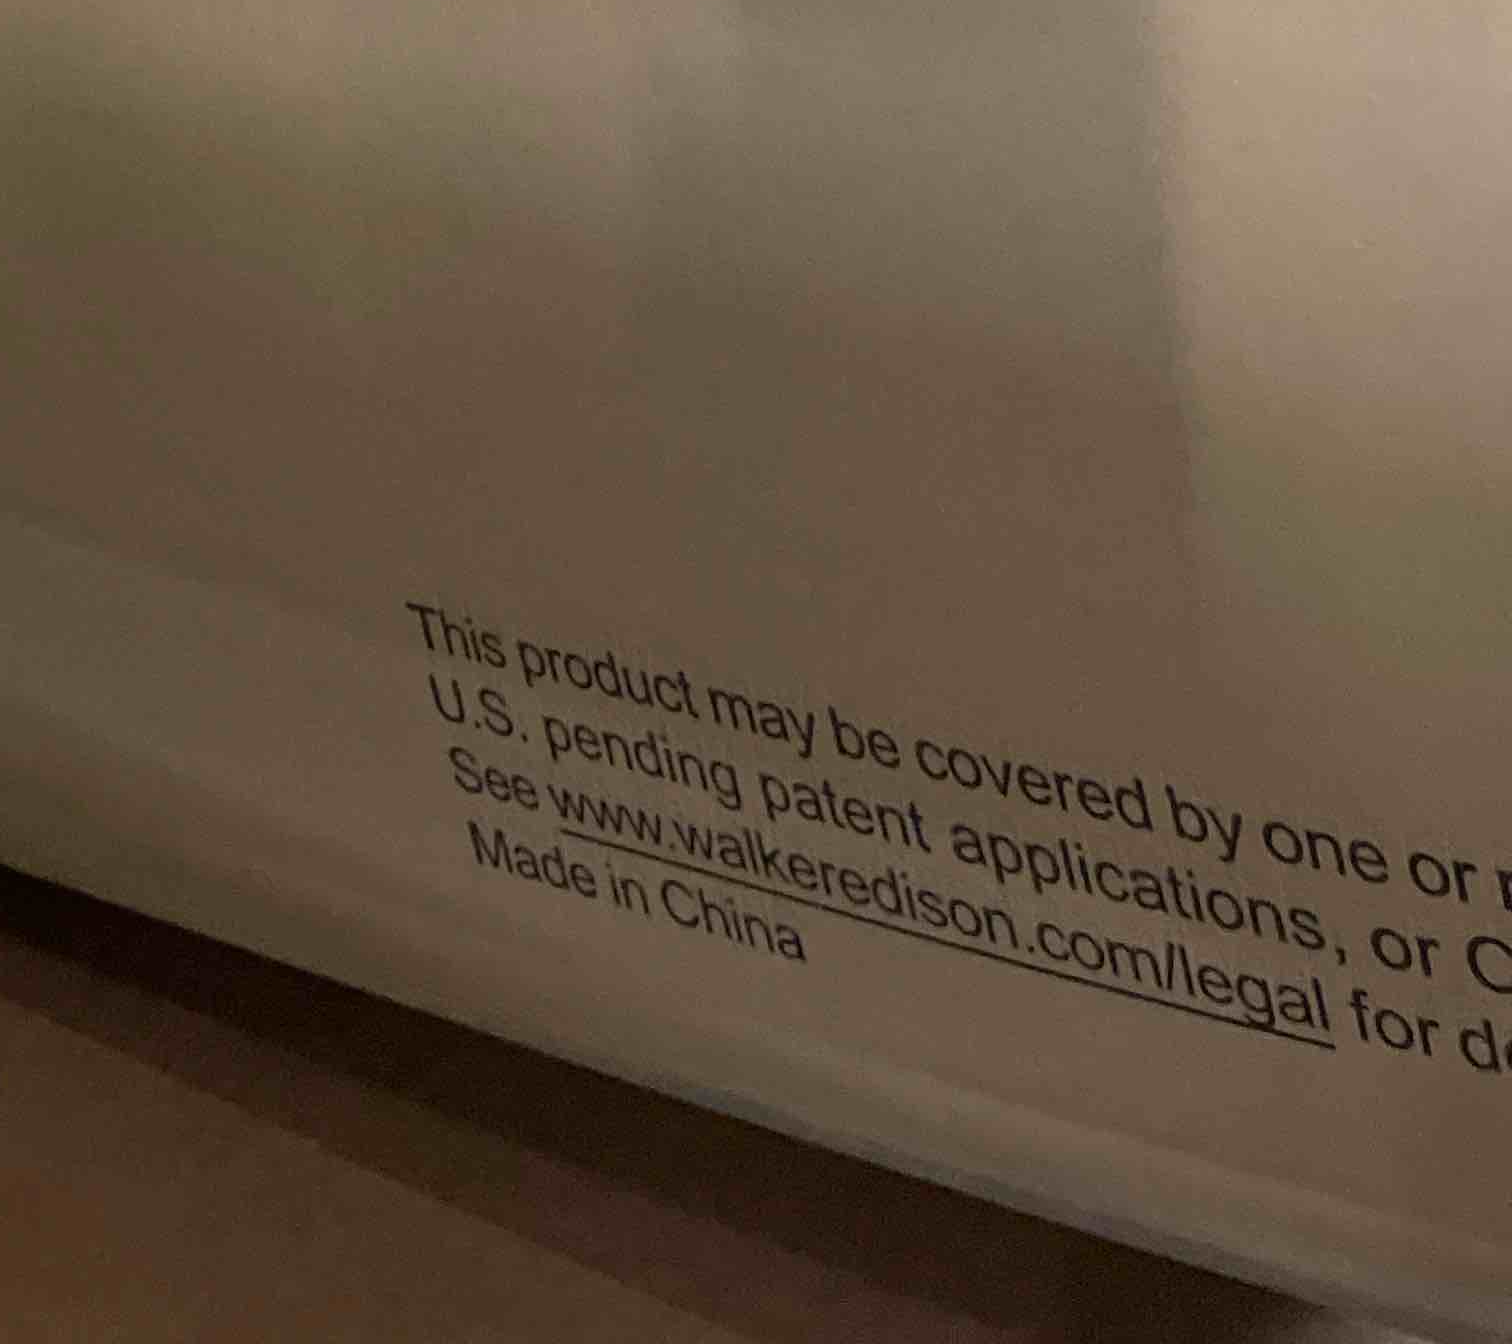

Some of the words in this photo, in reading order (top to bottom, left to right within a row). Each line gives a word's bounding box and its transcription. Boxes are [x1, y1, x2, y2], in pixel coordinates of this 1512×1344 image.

[405, 601, 507, 668] This
[517, 637, 699, 719] product
[707, 684, 815, 760] may
[828, 706, 901, 770] be
[915, 738, 1154, 833] covered
[1165, 783, 1243, 864] by
[1262, 820, 1389, 884] one
[1408, 851, 1478, 903] or
[429, 673, 530, 745] U.S.
[543, 714, 743, 811] pending
[758, 772, 932, 853] patent
[950, 823, 1348, 966] applications,
[1370, 927, 1440, 977] or
[448, 746, 540, 811] See
[548, 783, 1332, 1034] www.walkeredison.com/legal
[1349, 988, 1441, 1057] for
[467, 820, 597, 899] Made
[606, 862, 651, 917] in
[661, 879, 808, 963] China
